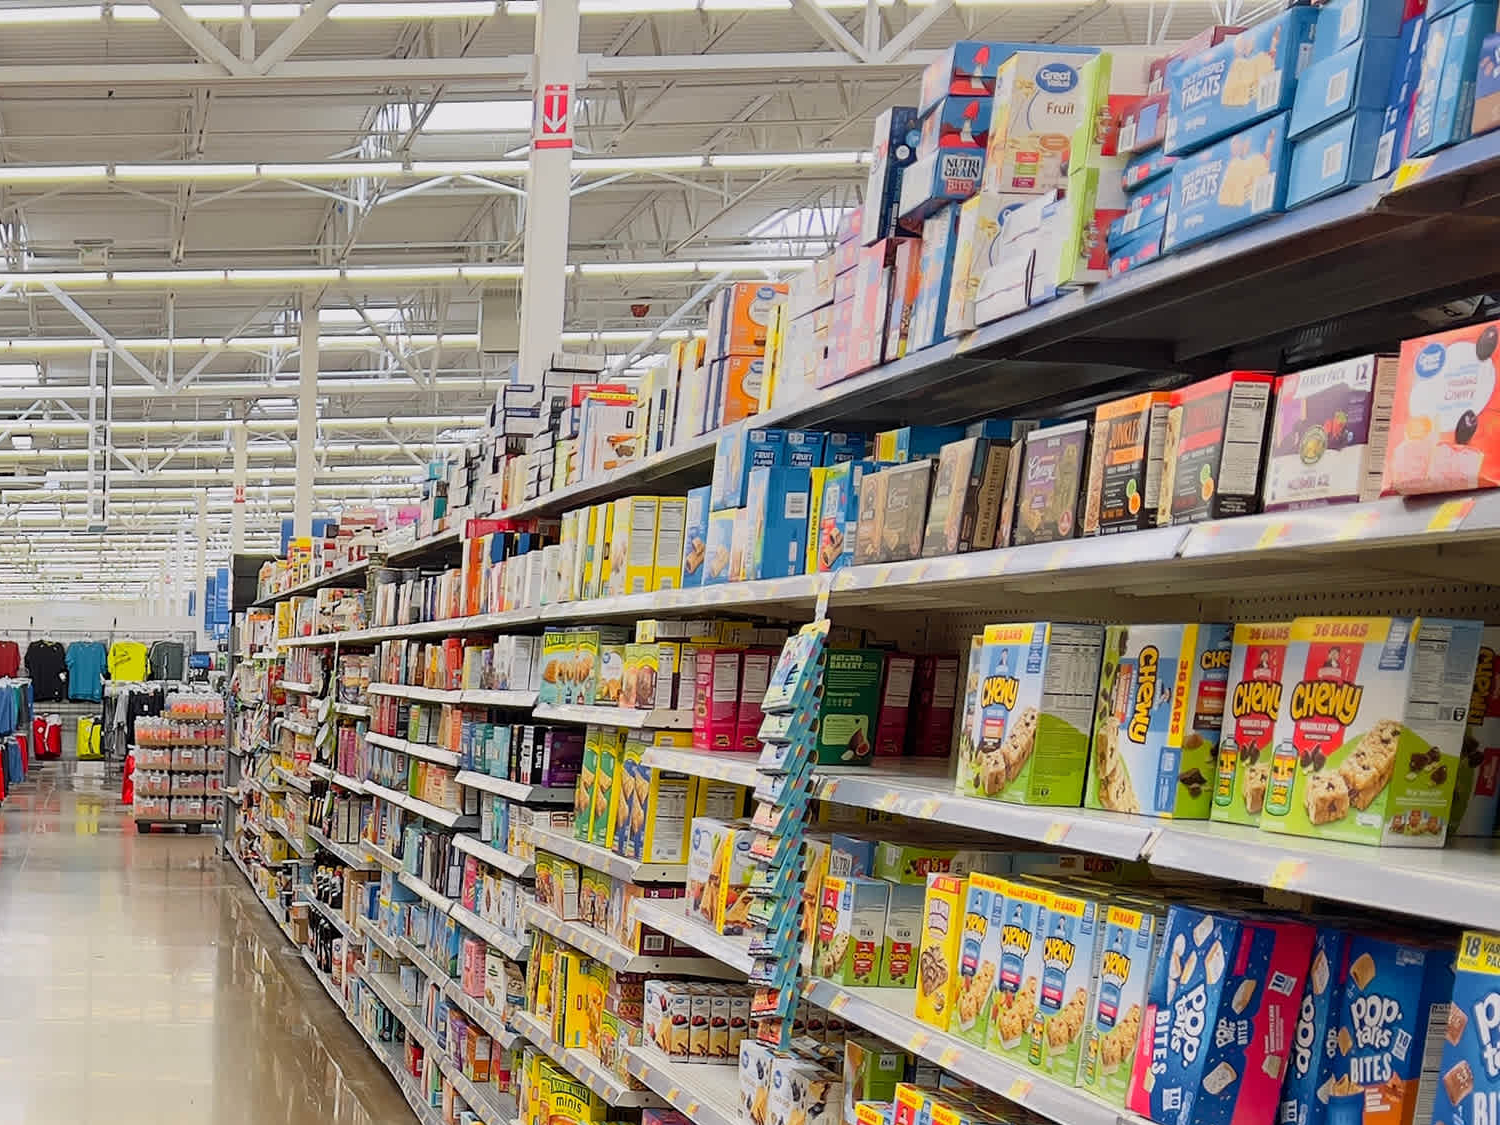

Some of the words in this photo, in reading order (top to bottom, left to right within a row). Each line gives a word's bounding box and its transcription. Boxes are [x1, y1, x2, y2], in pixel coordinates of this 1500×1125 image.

[1041, 69, 1072, 81] Great
[1046, 102, 1074, 115] Fruit
[946, 157, 980, 169] NUTRI
[944, 167, 979, 179] GRAIN
[1312, 623, 1327, 637] 36
[1329, 624, 1369, 637] BARS
[1465, 937, 1482, 958] 18
[1151, 1009, 1167, 1075] BITES
[1351, 1052, 1392, 1084] BITES
[556, 1095, 582, 1114] minis
